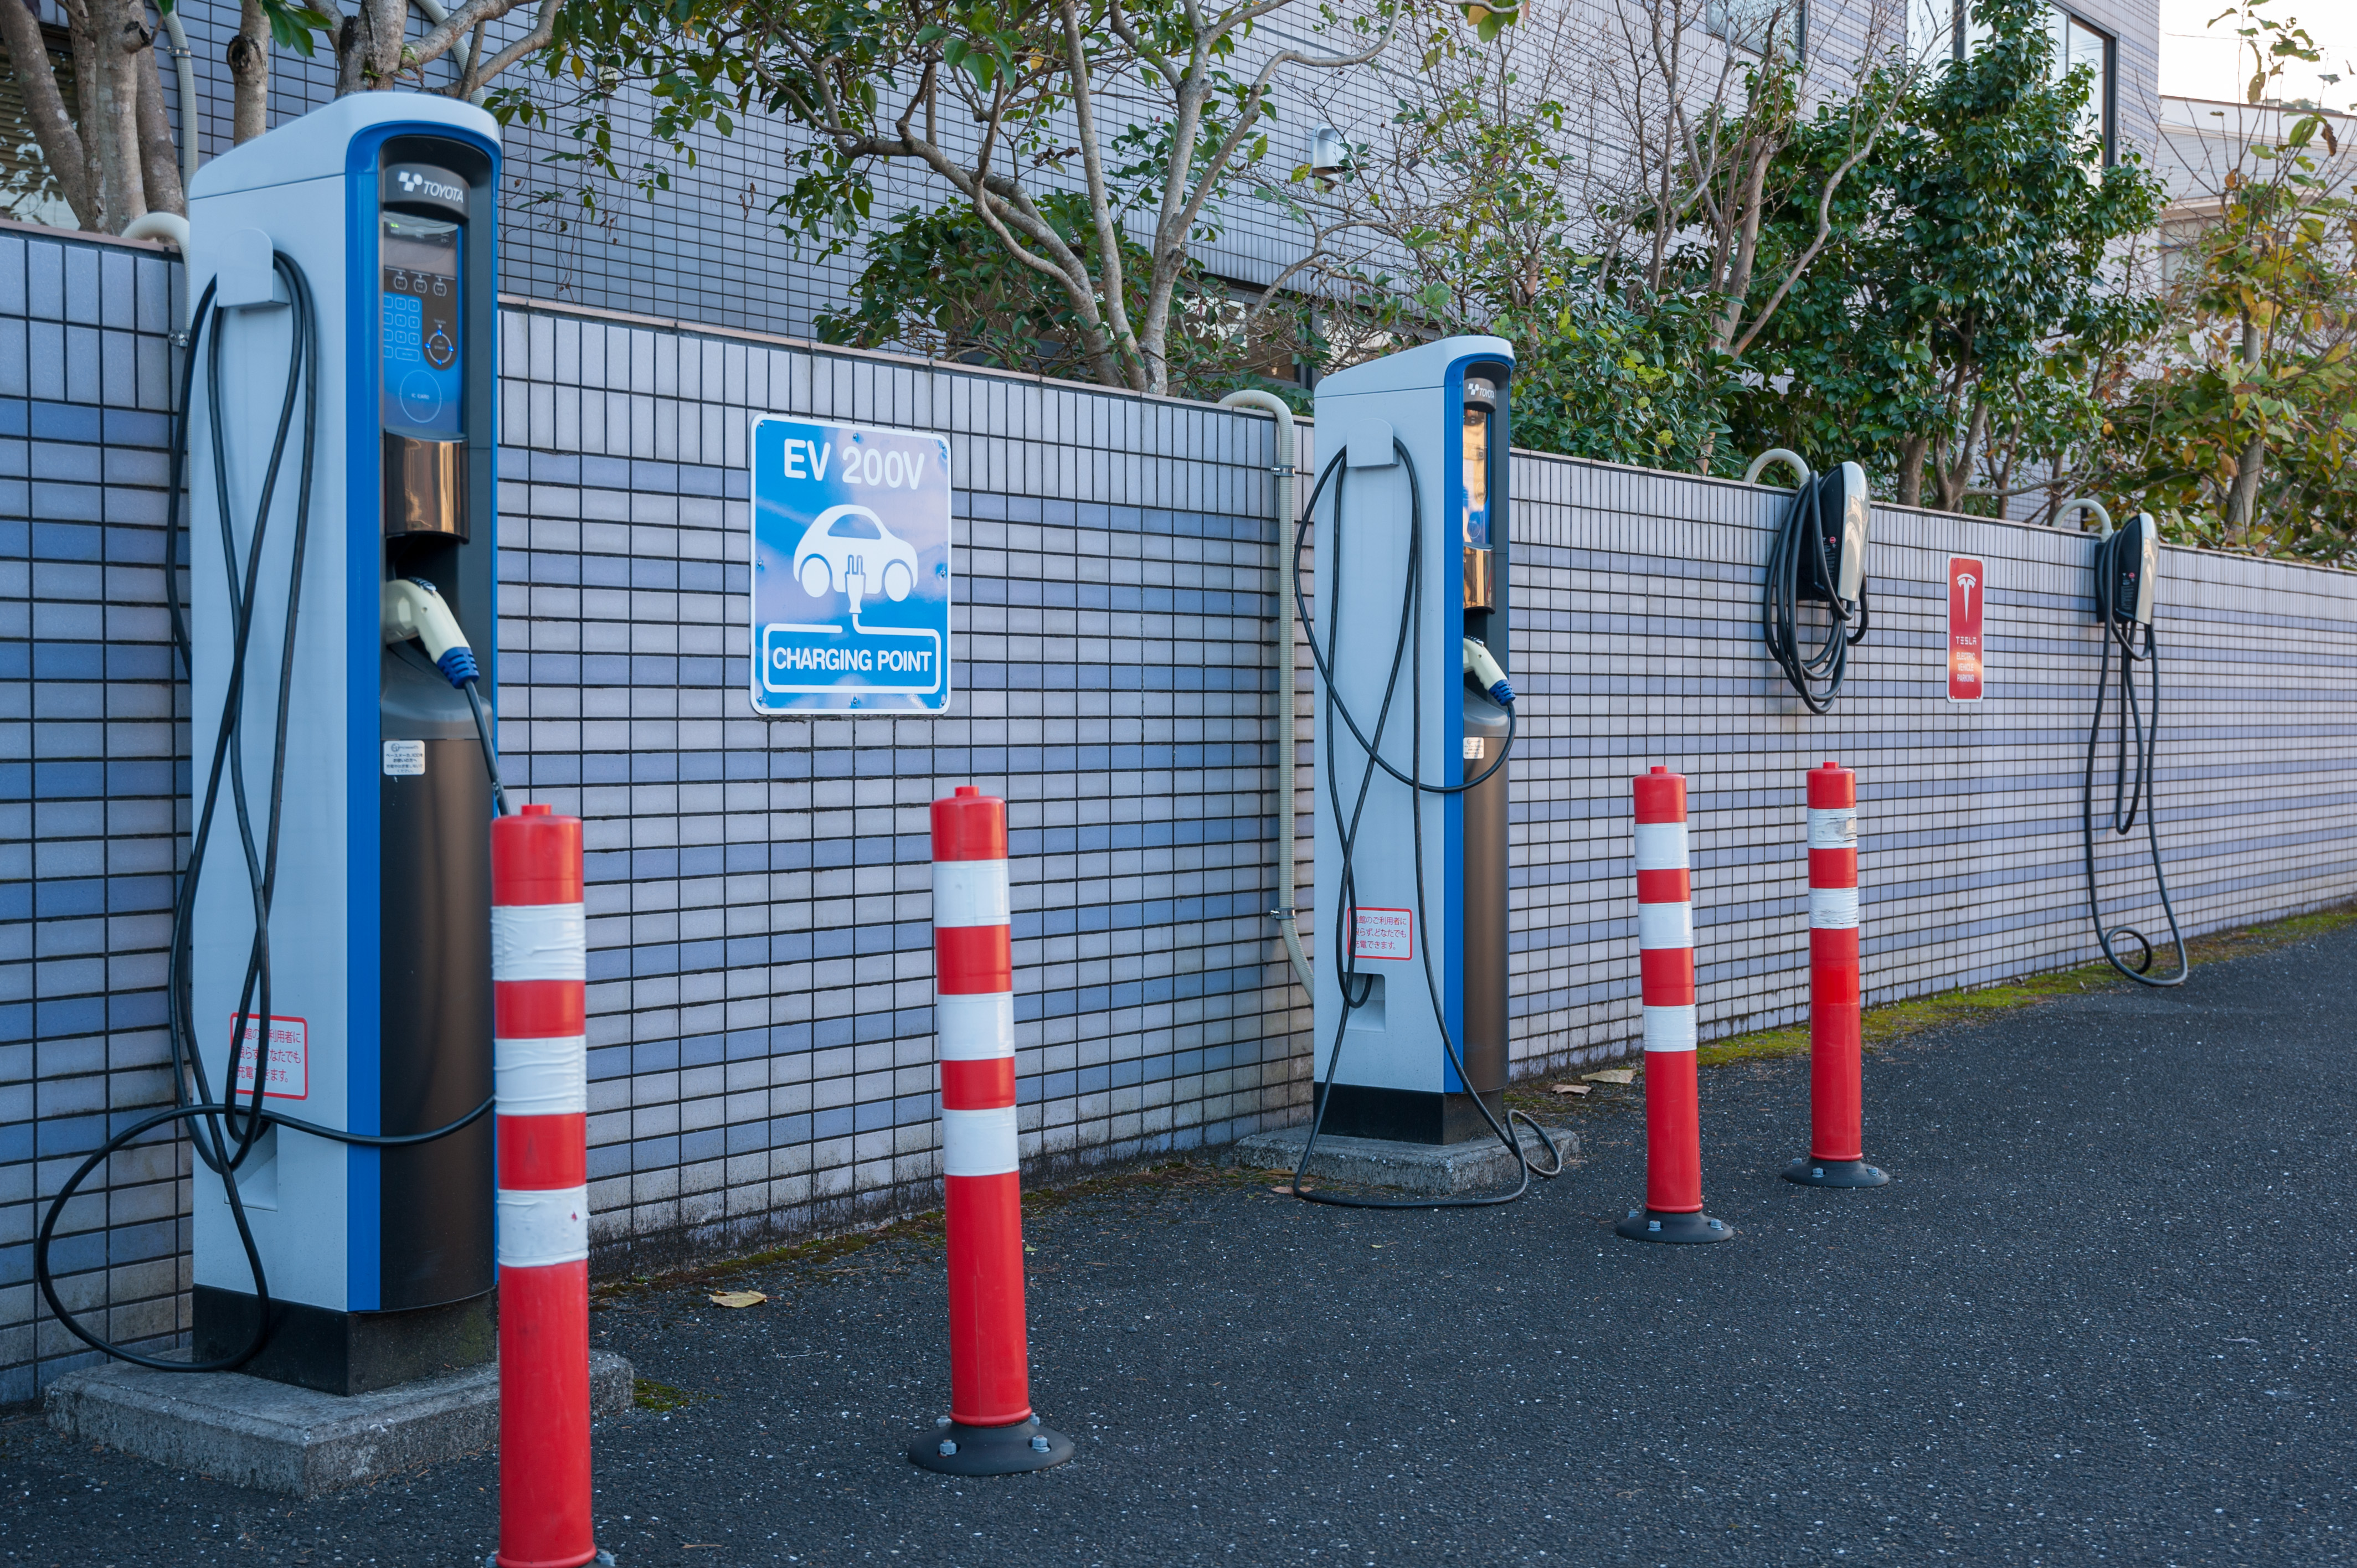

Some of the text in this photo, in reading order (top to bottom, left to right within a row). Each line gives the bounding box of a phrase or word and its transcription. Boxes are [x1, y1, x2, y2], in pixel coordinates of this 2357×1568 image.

[423, 181, 464, 204] TOYOTA
[1480, 388, 1495, 399] TOYOTA
[784, 438, 925, 490] EV 200V
[1955, 636, 1977, 644] TESLA
[773, 646, 932, 672] CHARGING POINT
[1956, 652, 1975, 661] ELECTRIC
[1958, 663, 1974, 672] VEHICLE
[1957, 674, 1975, 682] PARKING
